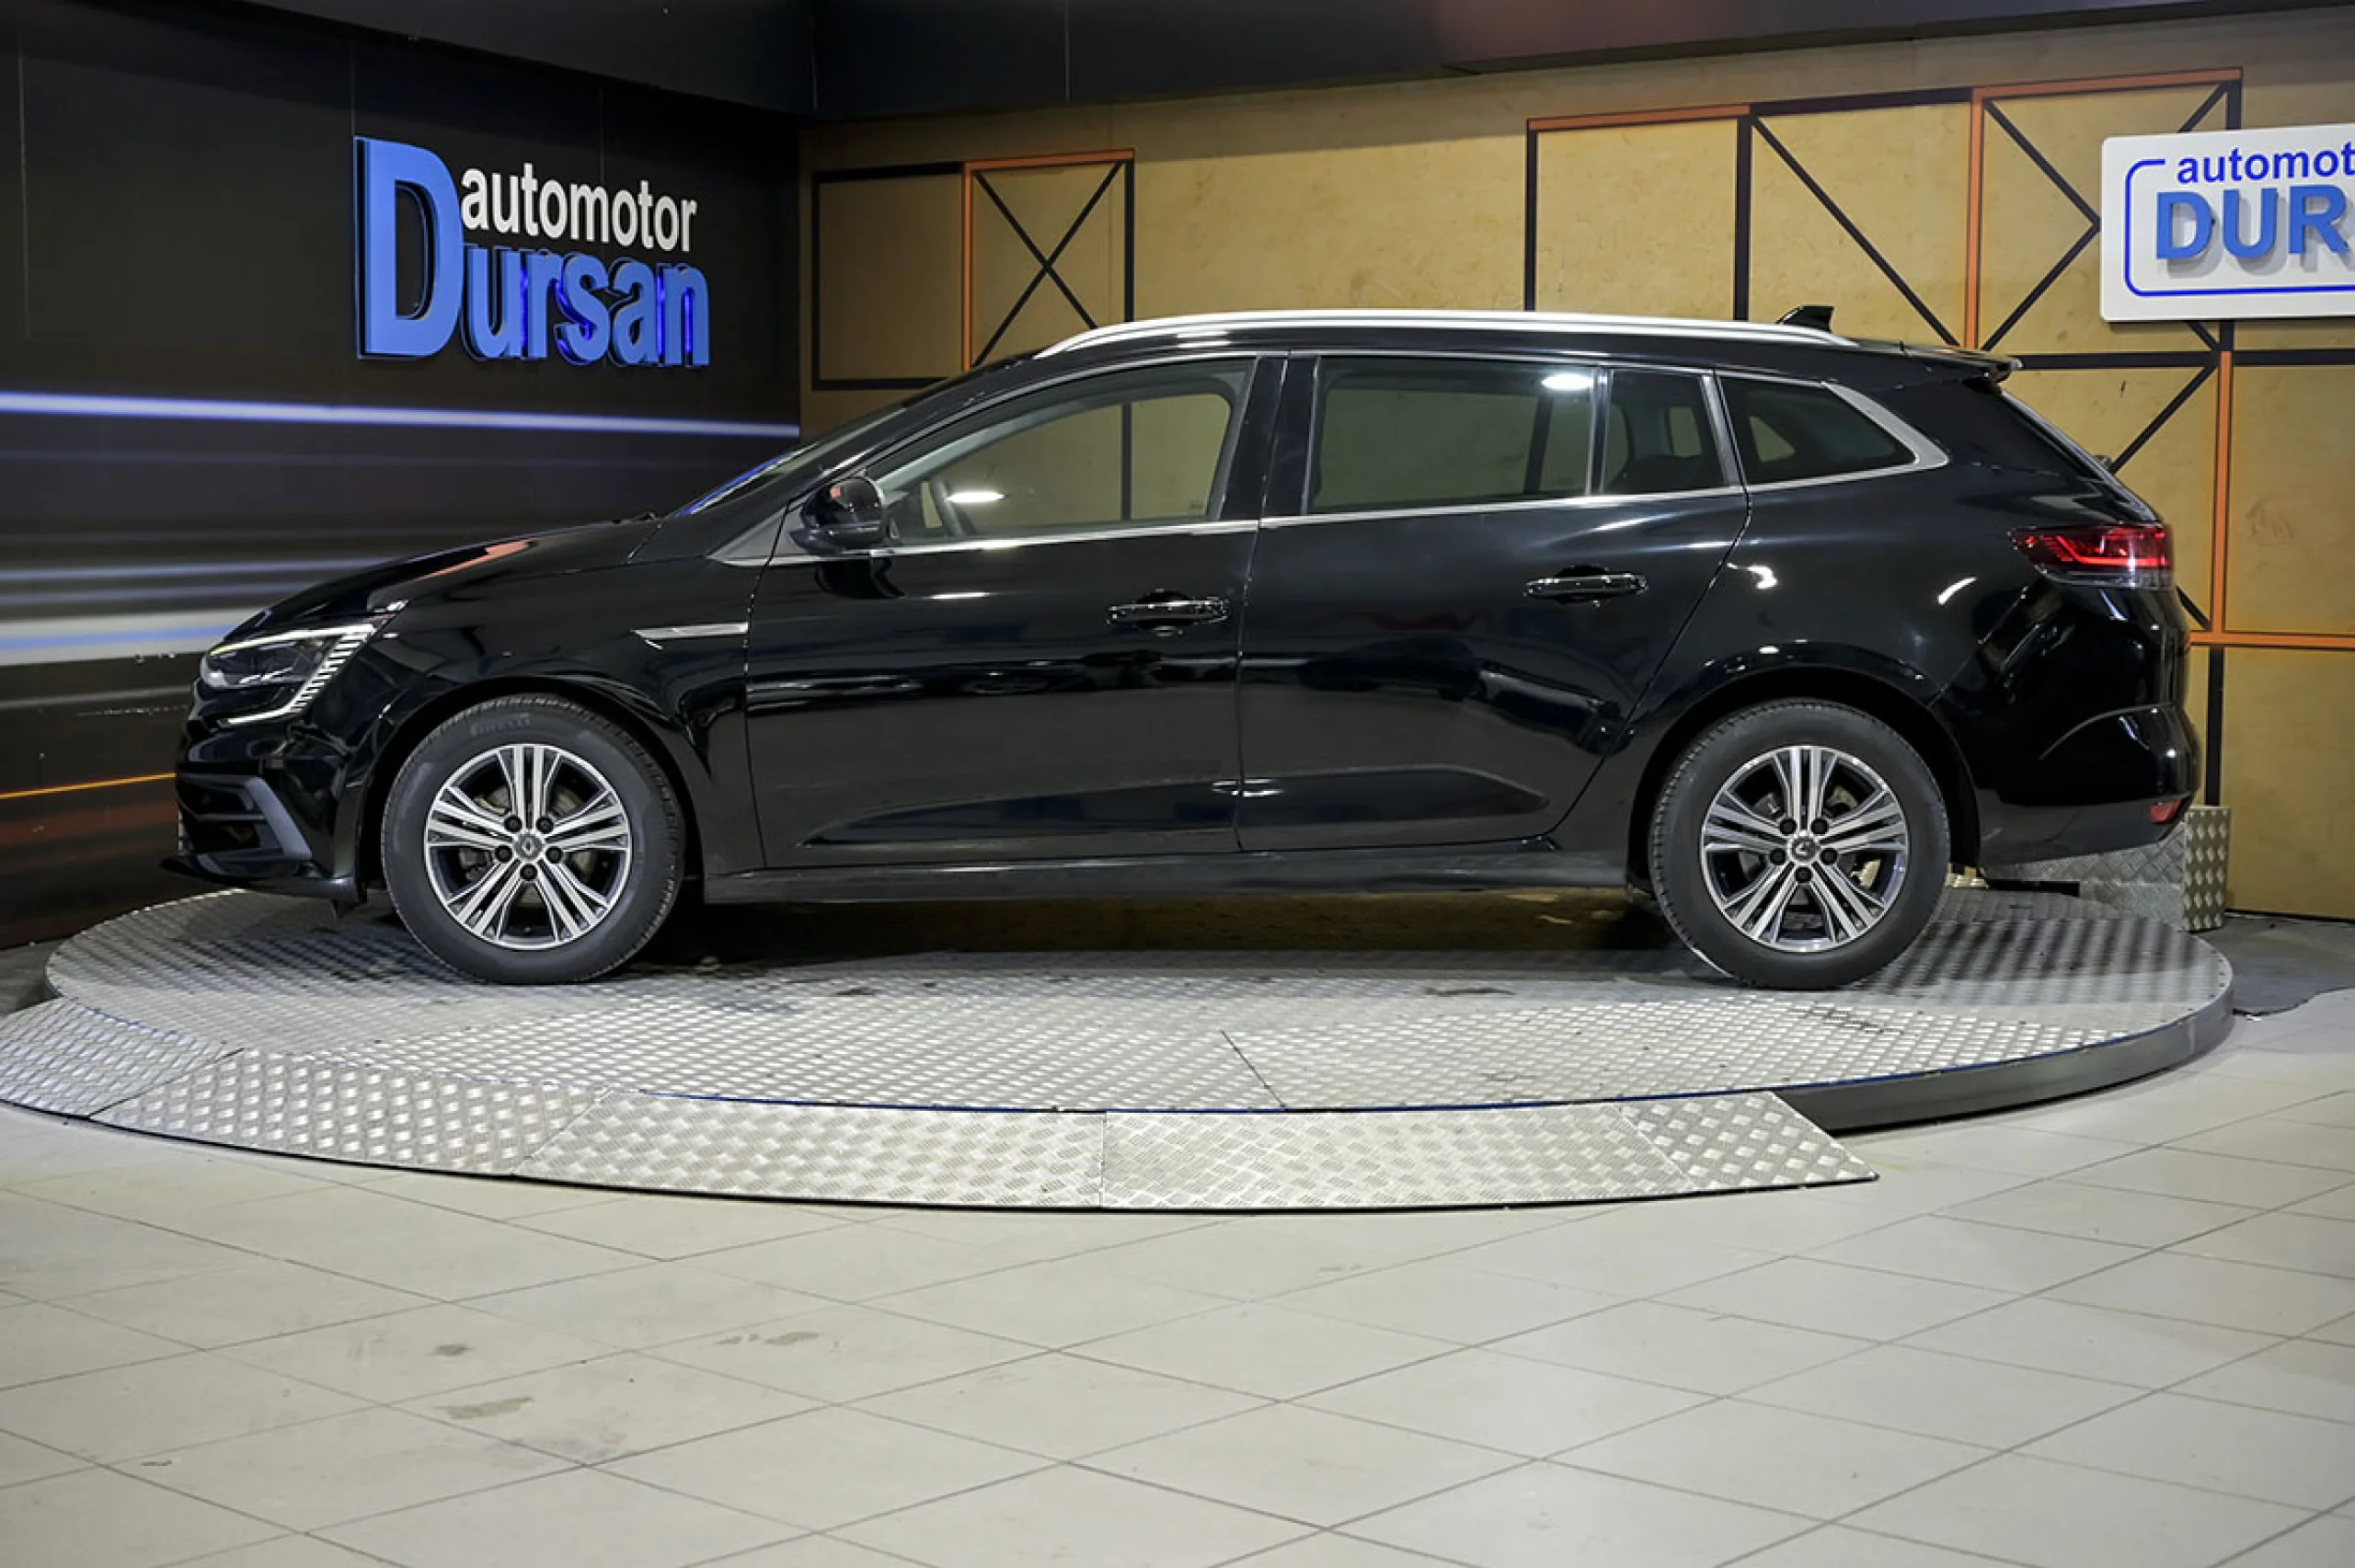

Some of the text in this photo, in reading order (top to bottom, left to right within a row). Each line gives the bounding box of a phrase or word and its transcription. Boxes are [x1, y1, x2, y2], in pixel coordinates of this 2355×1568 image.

[2177, 141, 2355, 184] automot
[461, 163, 697, 252] automotor
[2156, 184, 2351, 260] DUR
[354, 136, 710, 366] Dursan
